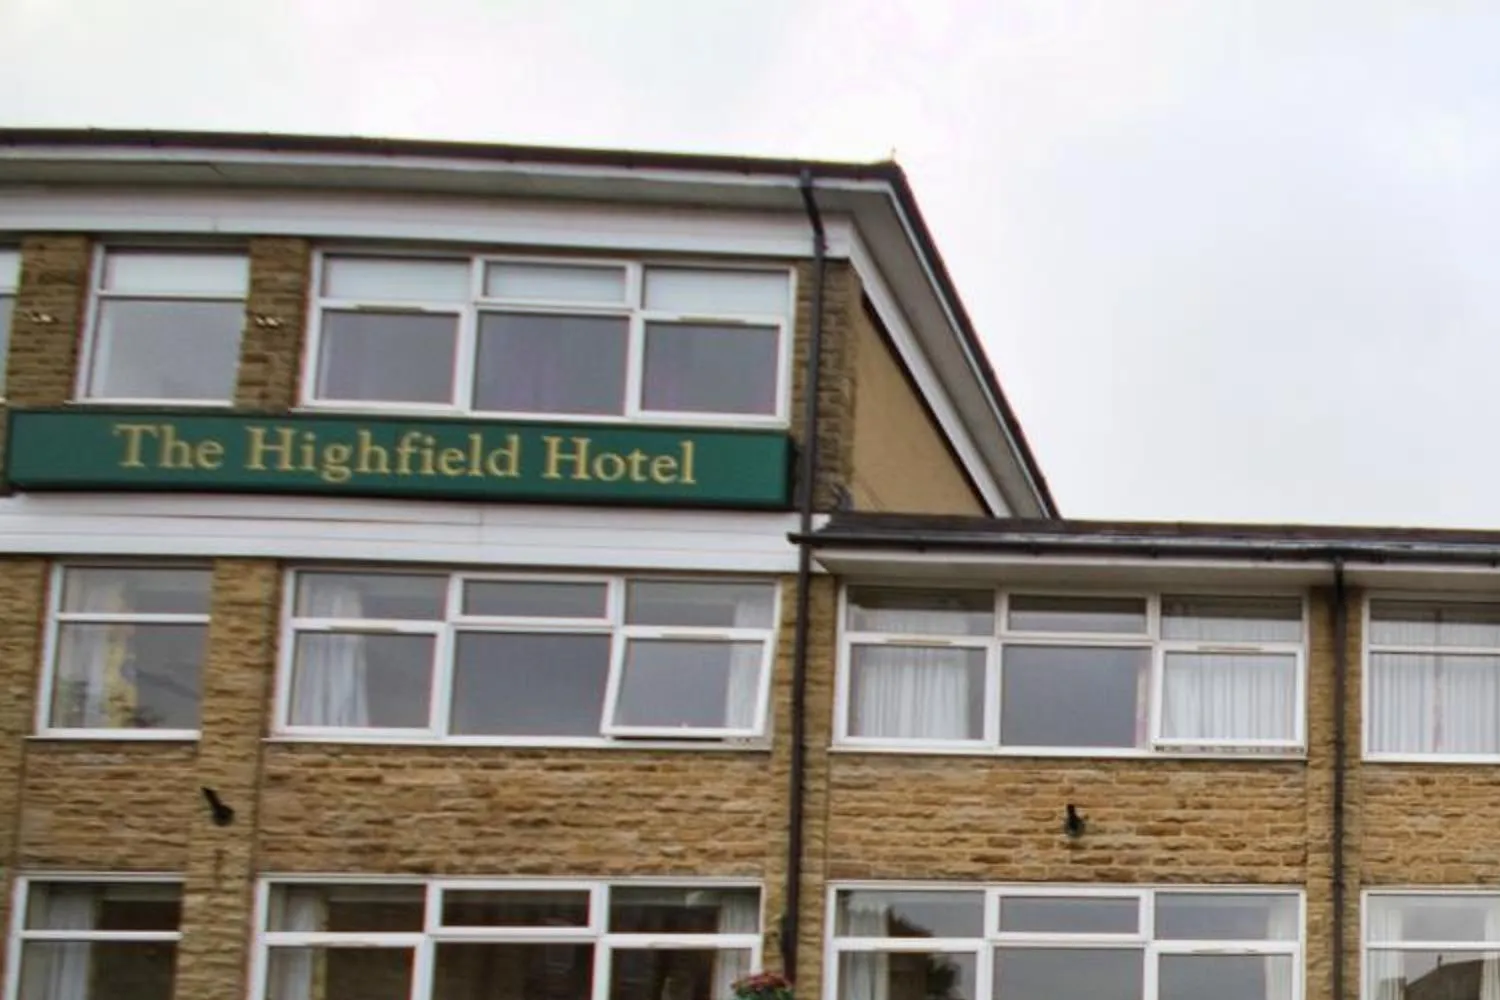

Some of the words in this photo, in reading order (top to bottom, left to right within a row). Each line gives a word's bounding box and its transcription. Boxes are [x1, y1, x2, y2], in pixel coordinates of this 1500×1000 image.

[113, 424, 225, 468] The
[244, 425, 521, 482] Highfield
[541, 435, 696, 484] Hotel
